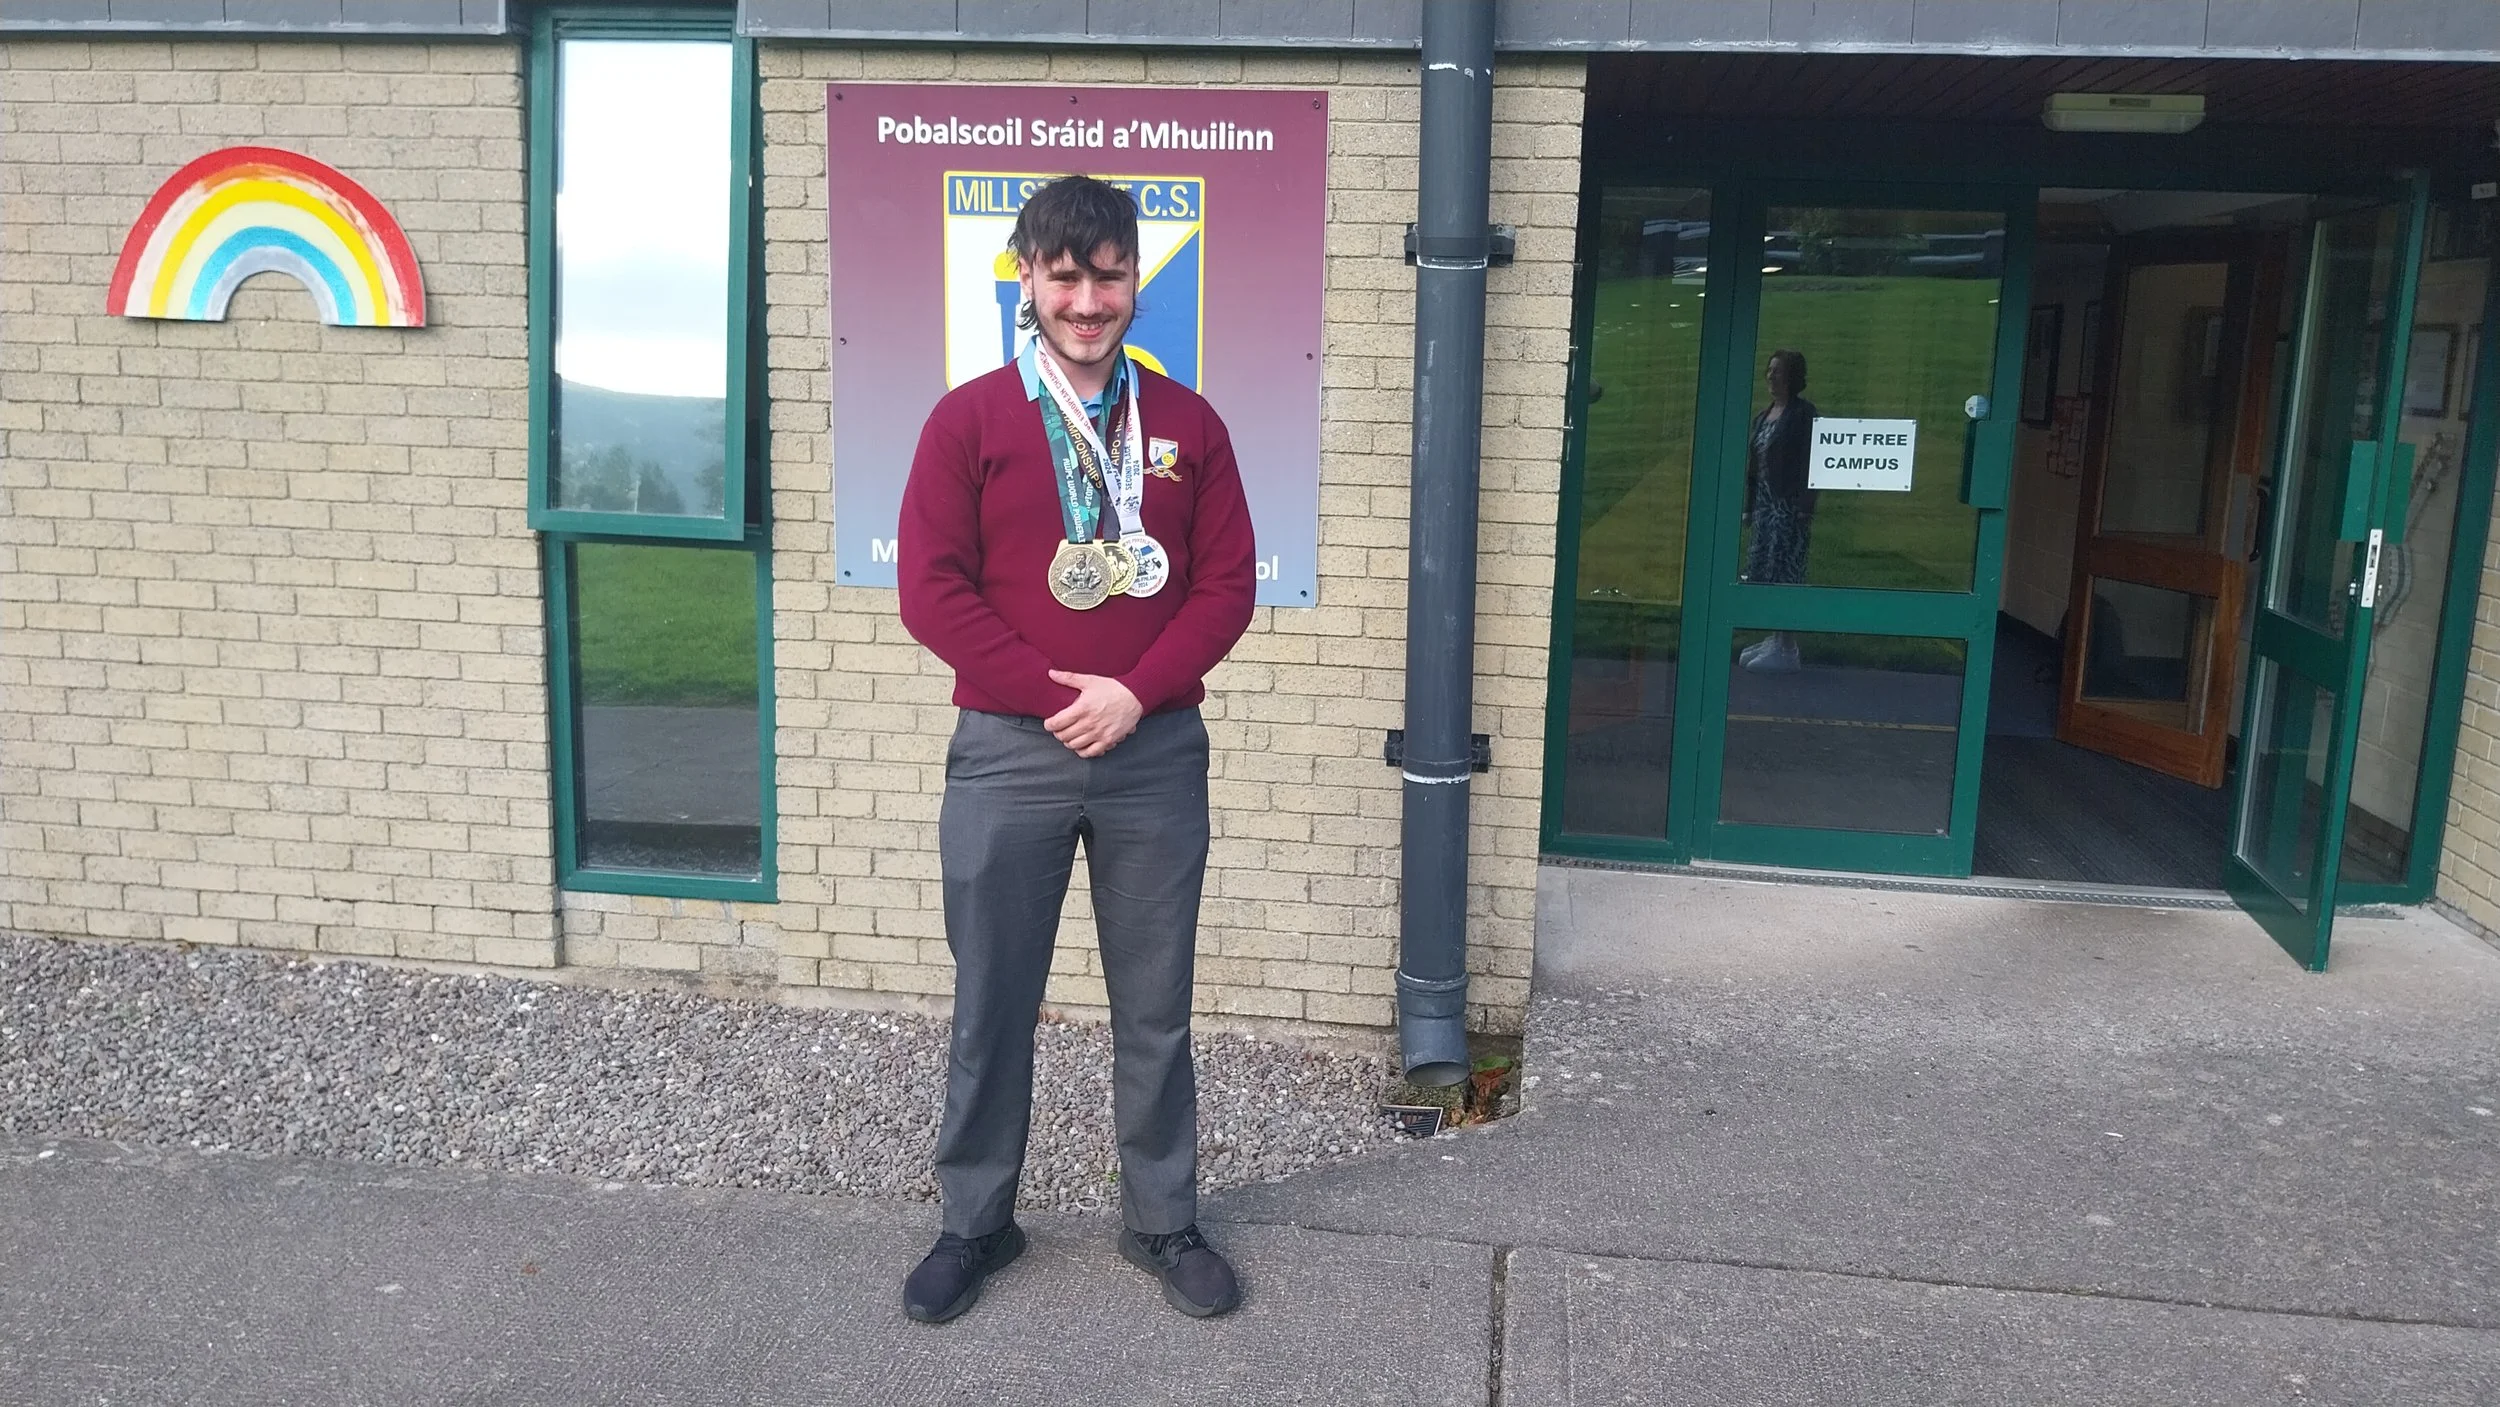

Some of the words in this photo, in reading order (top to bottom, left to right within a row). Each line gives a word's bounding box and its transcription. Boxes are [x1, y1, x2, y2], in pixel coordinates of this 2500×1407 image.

[877, 115, 1023, 146] Pobalscoil
[1030, 119, 1104, 148] Sráid
[1140, 184, 1196, 218] C.S.
[1062, 411, 1104, 489] AMPIONSHIPS
[1111, 439, 1121, 466] AIPO
[1819, 432, 1857, 446] NUT
[1862, 434, 1908, 446] FREE
[1823, 457, 1899, 471] CAMPUS
[1125, 465, 1133, 491] SECOND
[1067, 480, 1079, 507] WORLD
